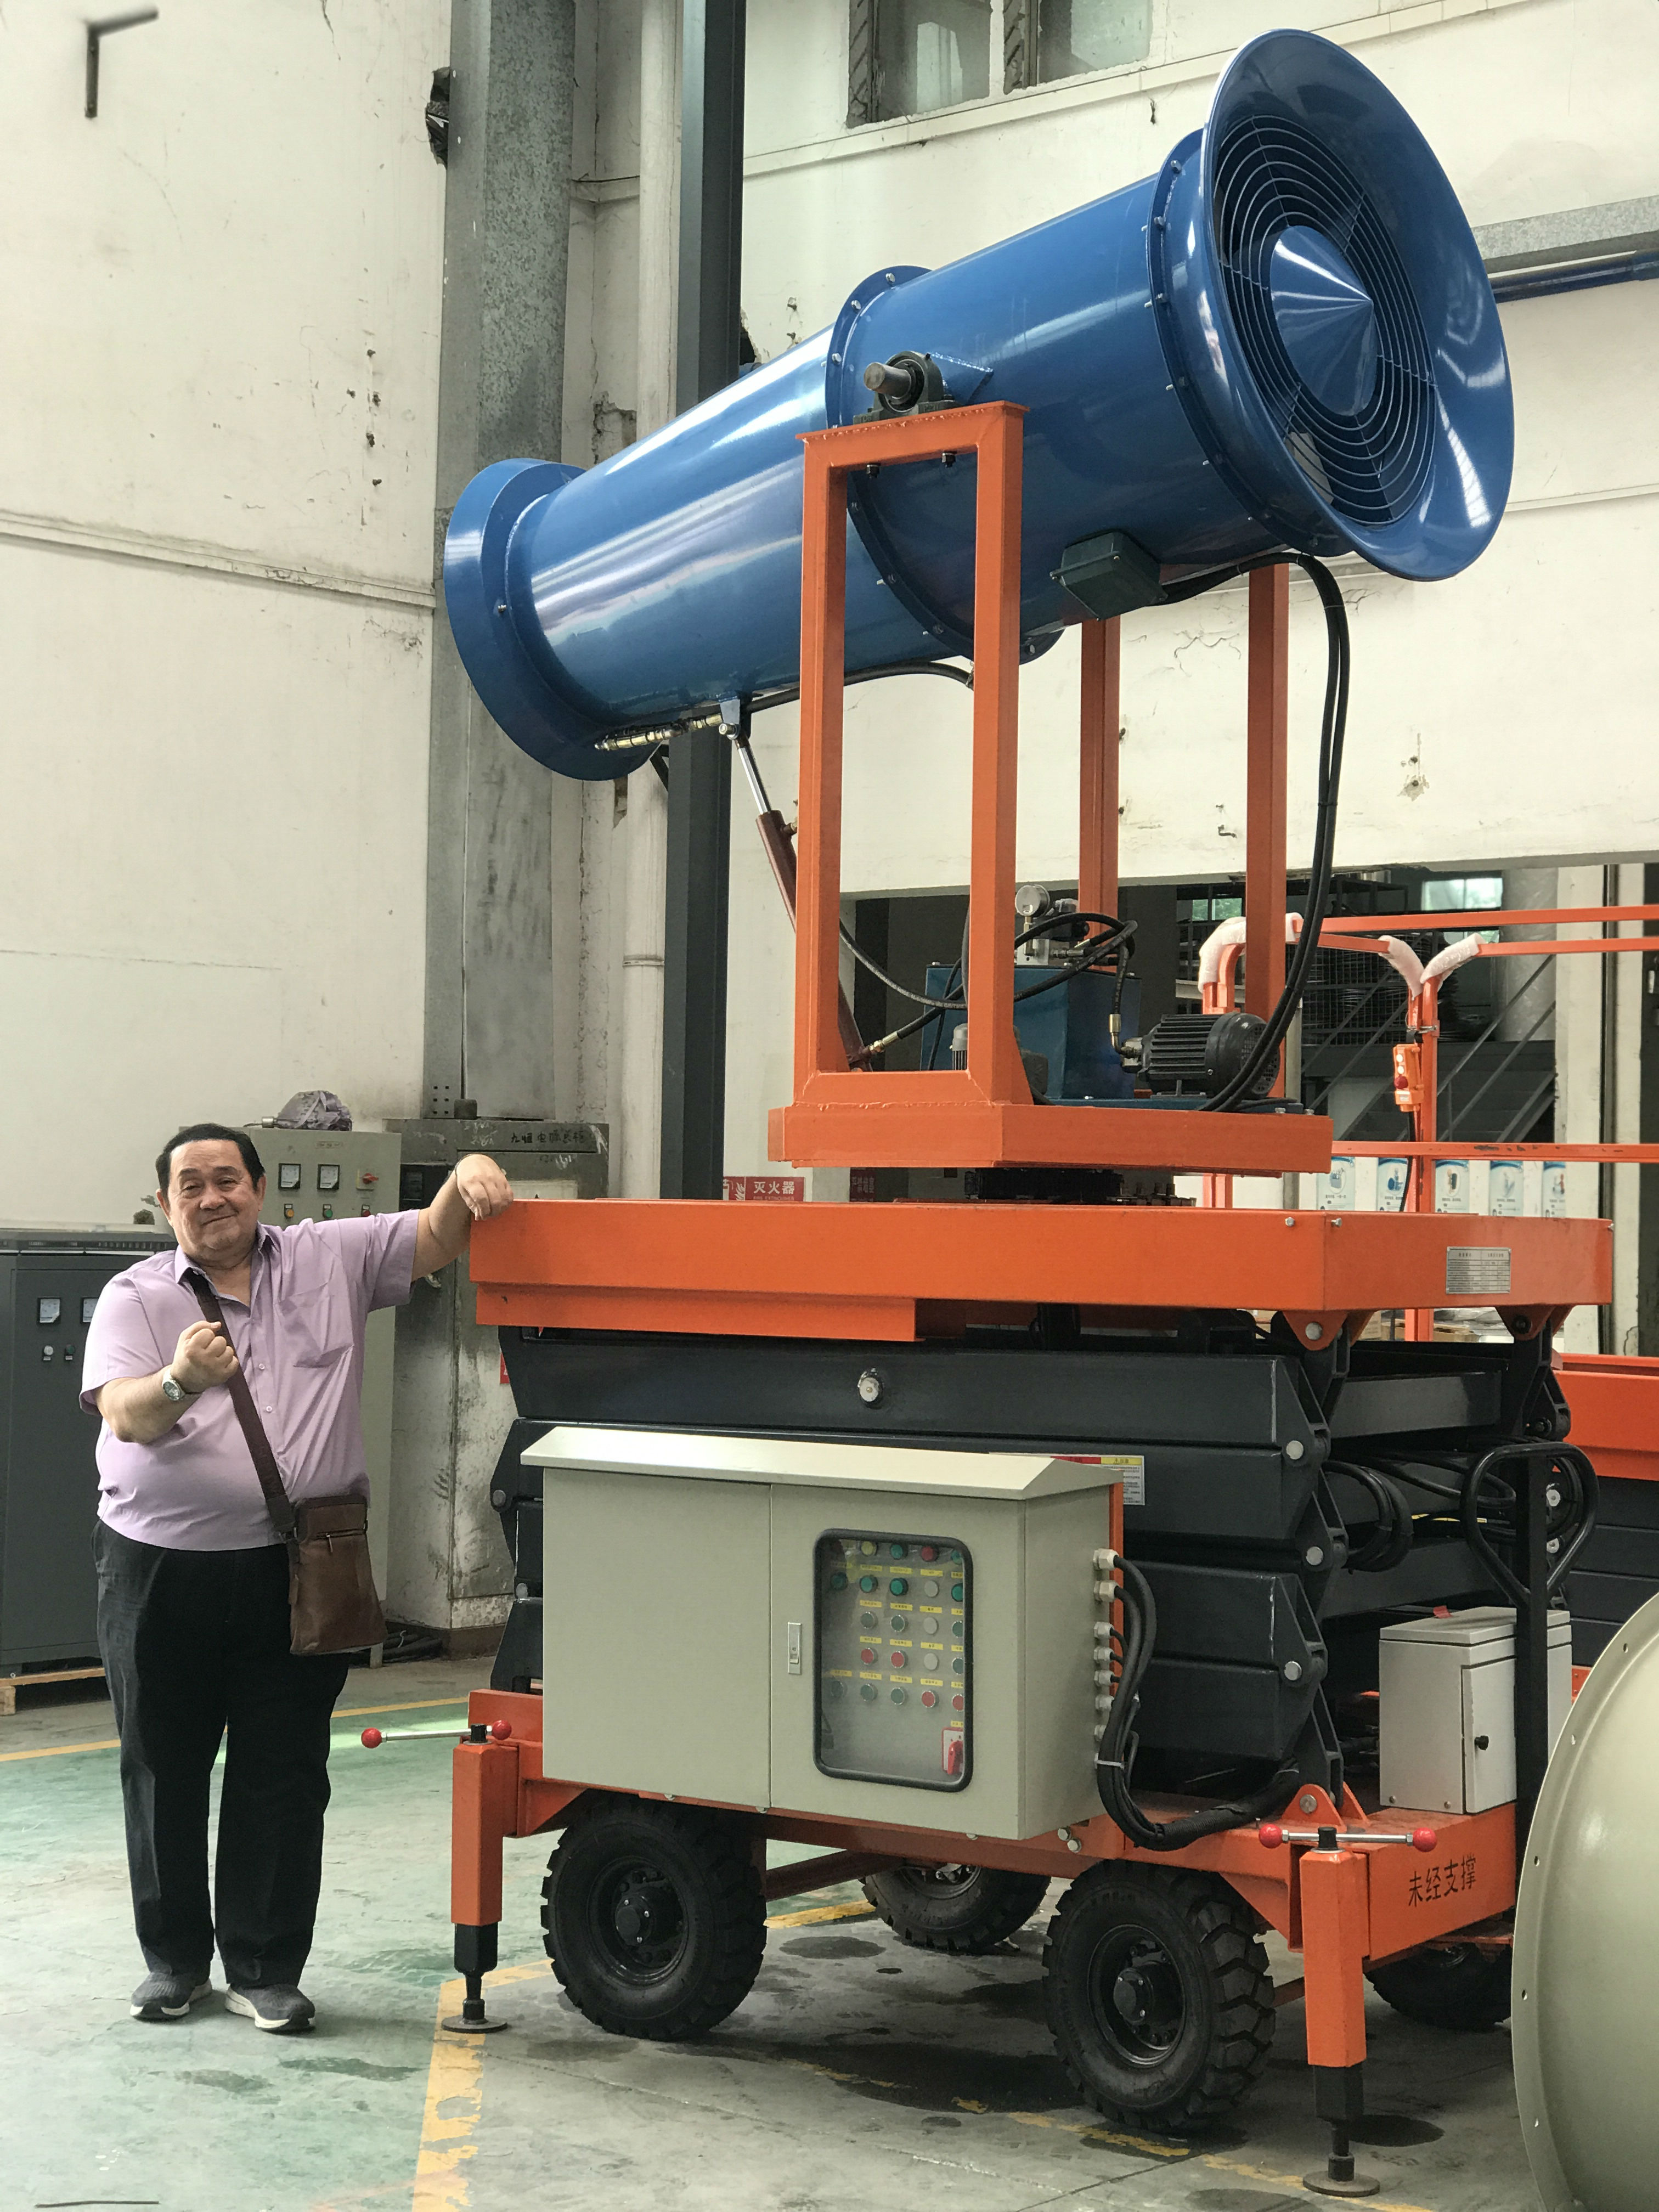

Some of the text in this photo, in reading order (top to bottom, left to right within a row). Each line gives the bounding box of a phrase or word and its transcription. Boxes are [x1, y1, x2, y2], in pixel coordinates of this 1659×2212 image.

[753, 1181, 794, 1194] 灭火器
[1408, 1853, 1476, 1907] 未经支撑
